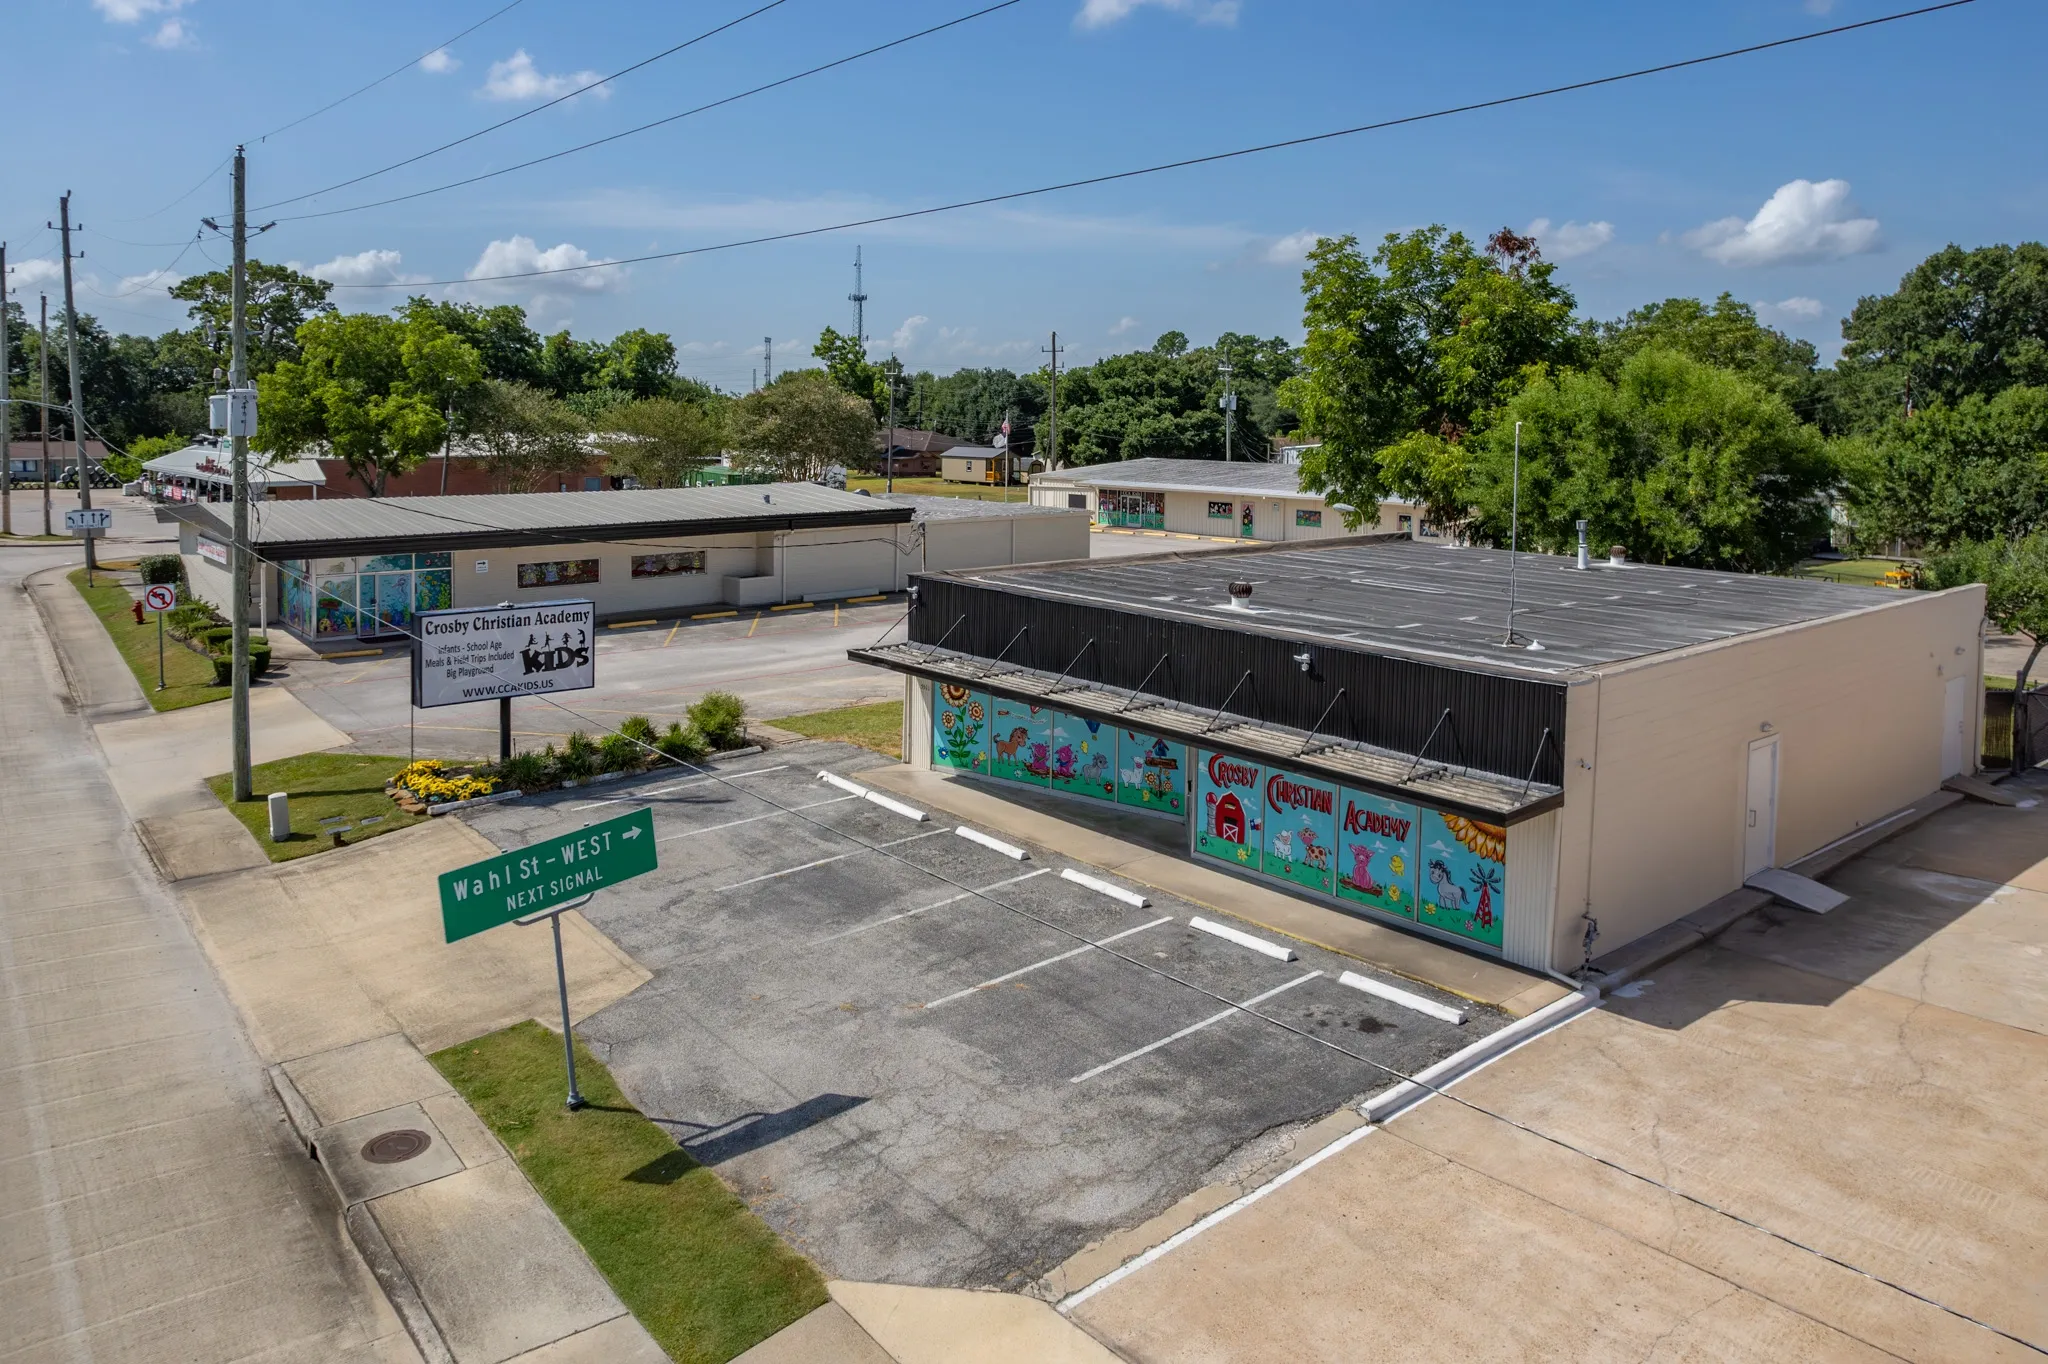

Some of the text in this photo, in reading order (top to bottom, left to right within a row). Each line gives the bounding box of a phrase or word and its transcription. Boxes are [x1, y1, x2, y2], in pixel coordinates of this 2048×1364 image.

[425, 609, 590, 636] Crosby Christian Academy
[425, 658, 444, 668] Meals
[446, 656, 452, 666] &
[470, 654, 487, 664] Trips
[488, 650, 515, 661] Included
[466, 641, 488, 652] School
[490, 641, 502, 651] Age
[446, 664, 494, 679] Big Playground
[520, 646, 590, 676] KIDS
[462, 679, 554, 698] WWW.CCAKIDS.US
[1208, 753, 1412, 843] CROSBY CHRISTIAN ACADEMY
[452, 865, 511, 902] Wahl
[506, 866, 603, 912] NEXT SIGNAL
